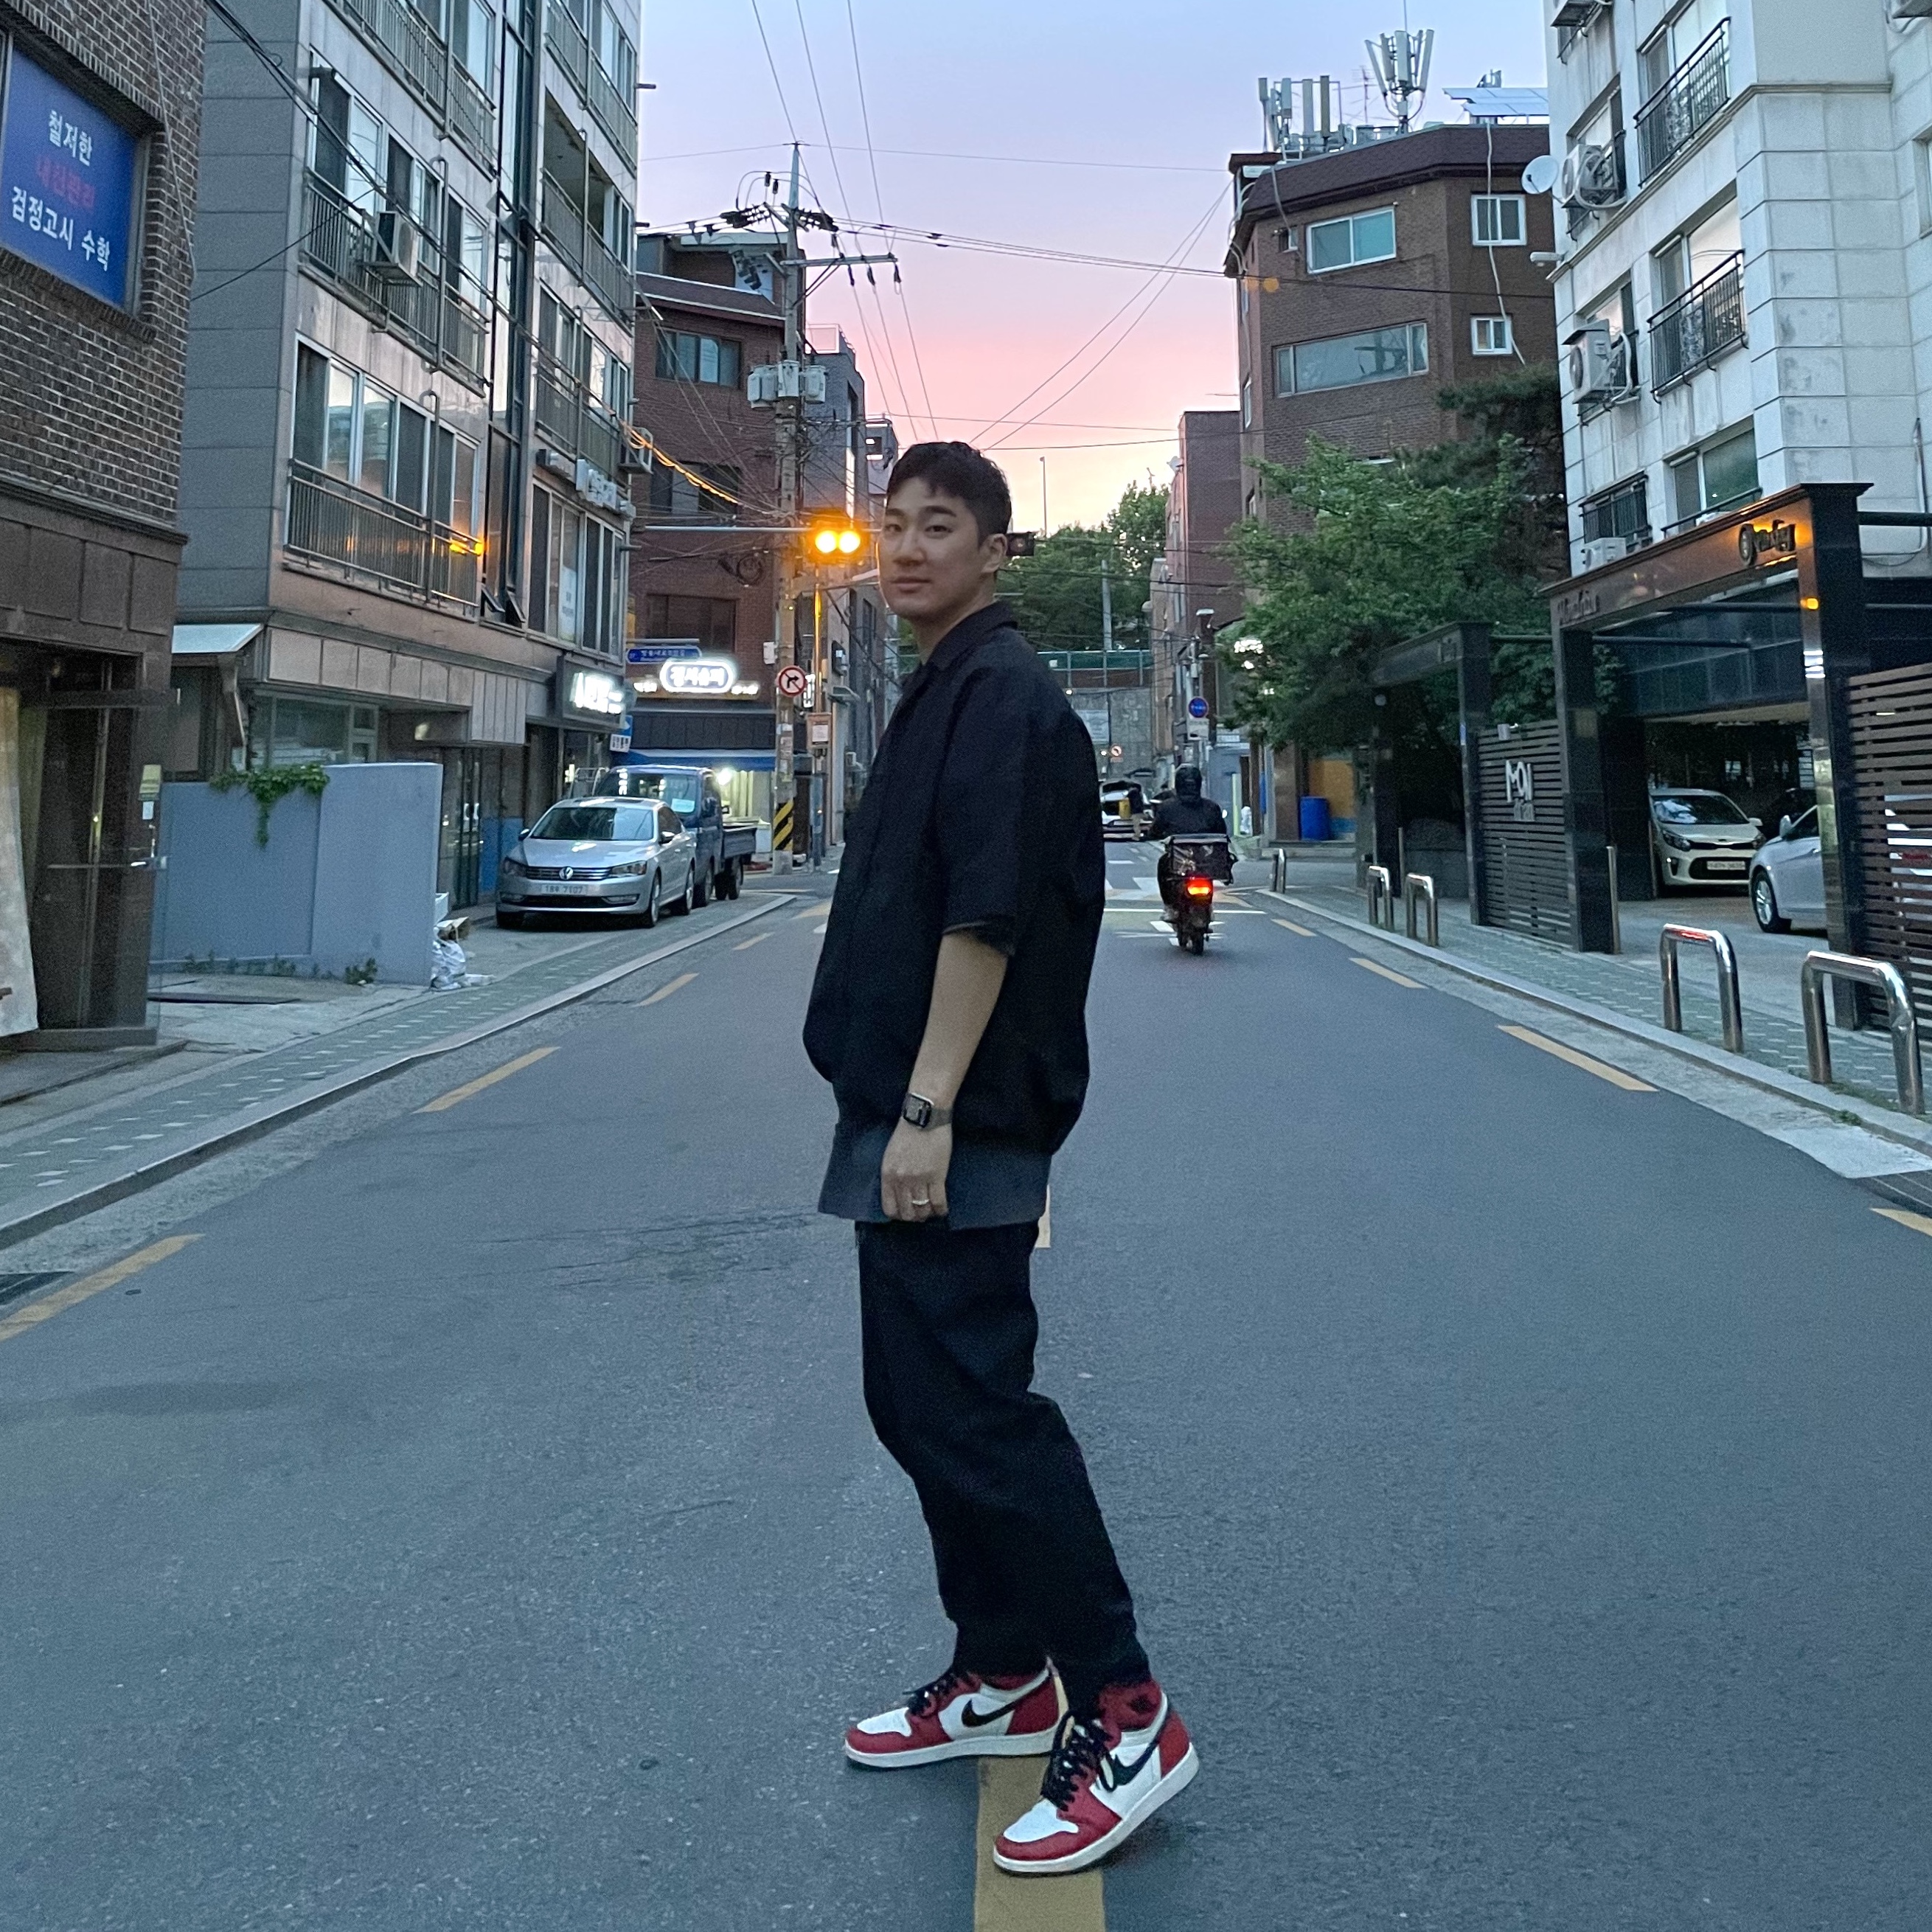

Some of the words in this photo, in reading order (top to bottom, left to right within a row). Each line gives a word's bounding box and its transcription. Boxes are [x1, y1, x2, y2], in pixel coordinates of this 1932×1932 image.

[49, 110, 92, 167] 철저한
[12, 186, 74, 251] 검정고시
[81, 230, 110, 271] 수학
